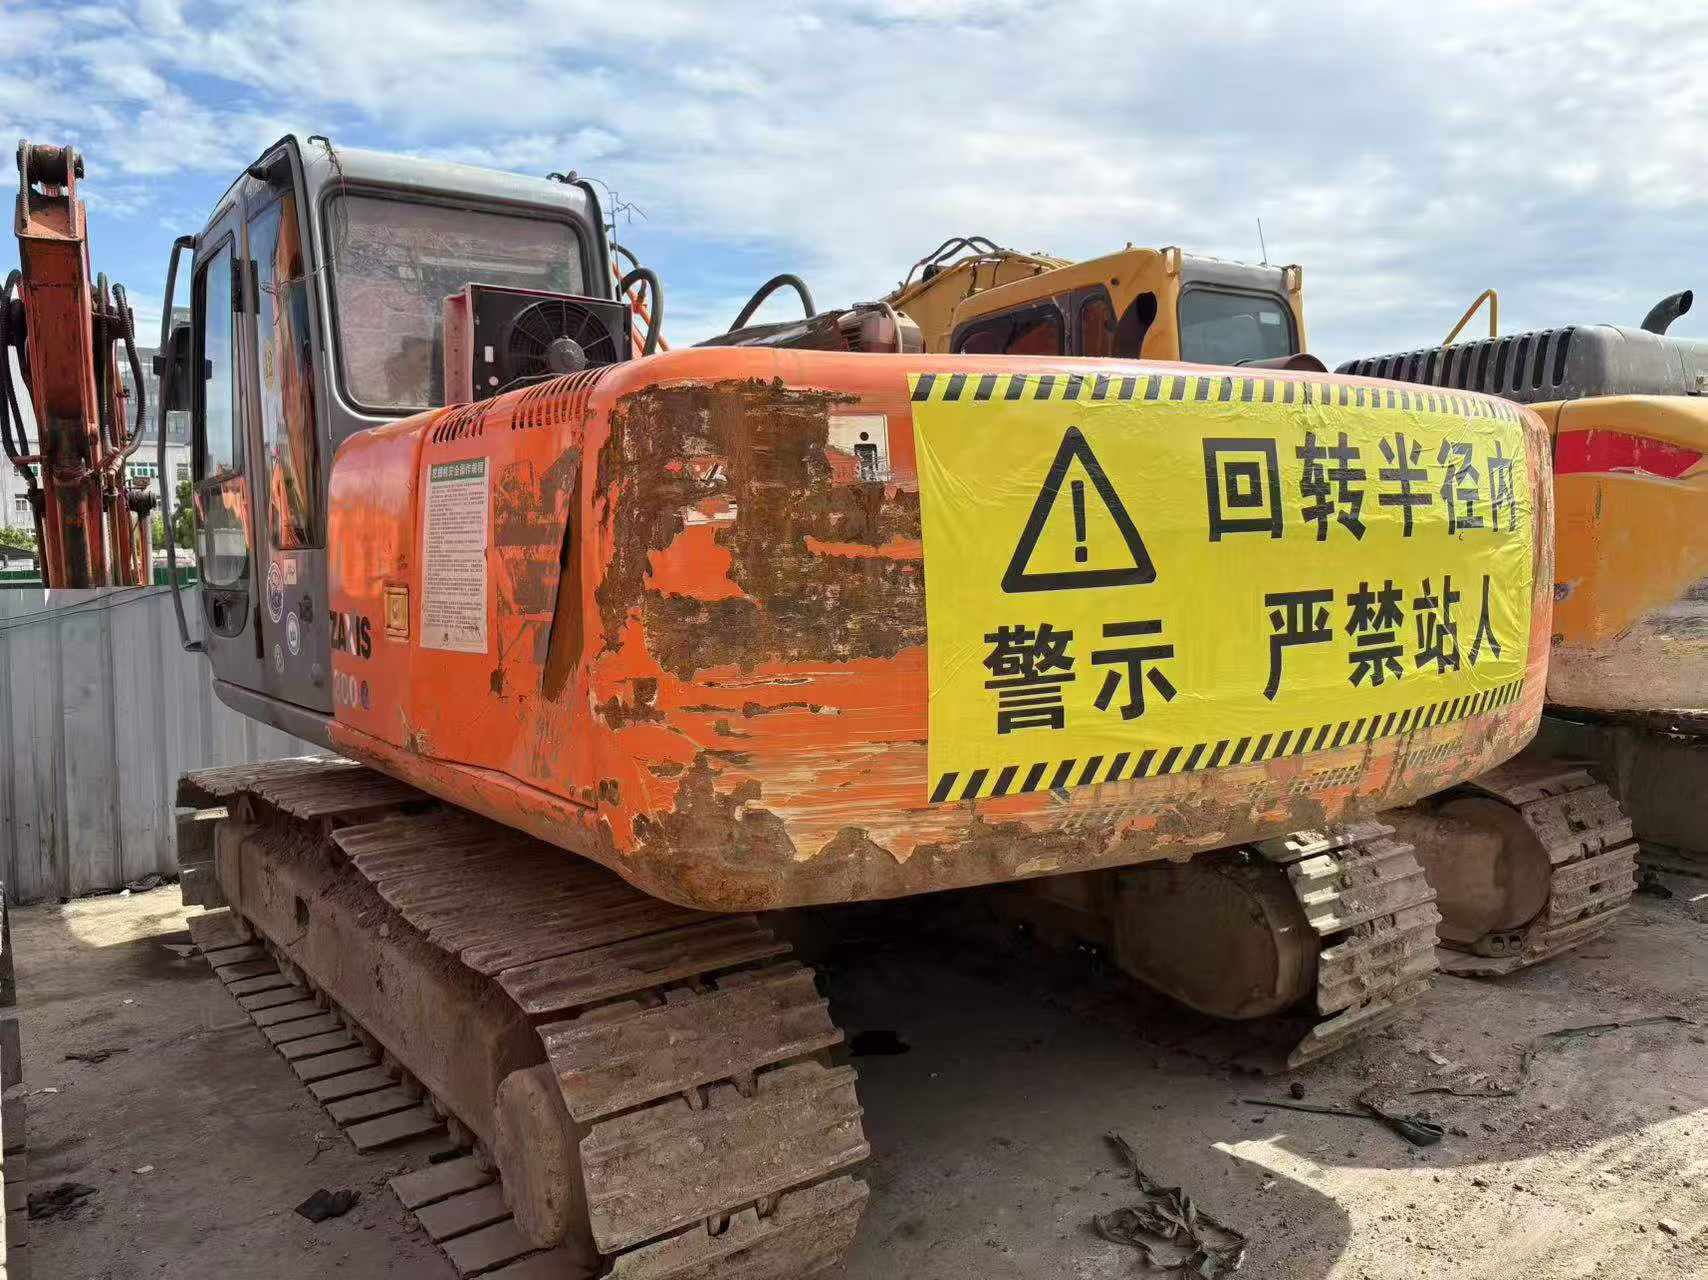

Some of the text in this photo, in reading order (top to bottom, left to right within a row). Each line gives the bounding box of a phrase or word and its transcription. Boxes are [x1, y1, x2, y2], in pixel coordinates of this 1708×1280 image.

[1202, 431, 1518, 542] 回转半径内
[983, 619, 1178, 735] 警示
[1263, 575, 1502, 702] 严禁站人
